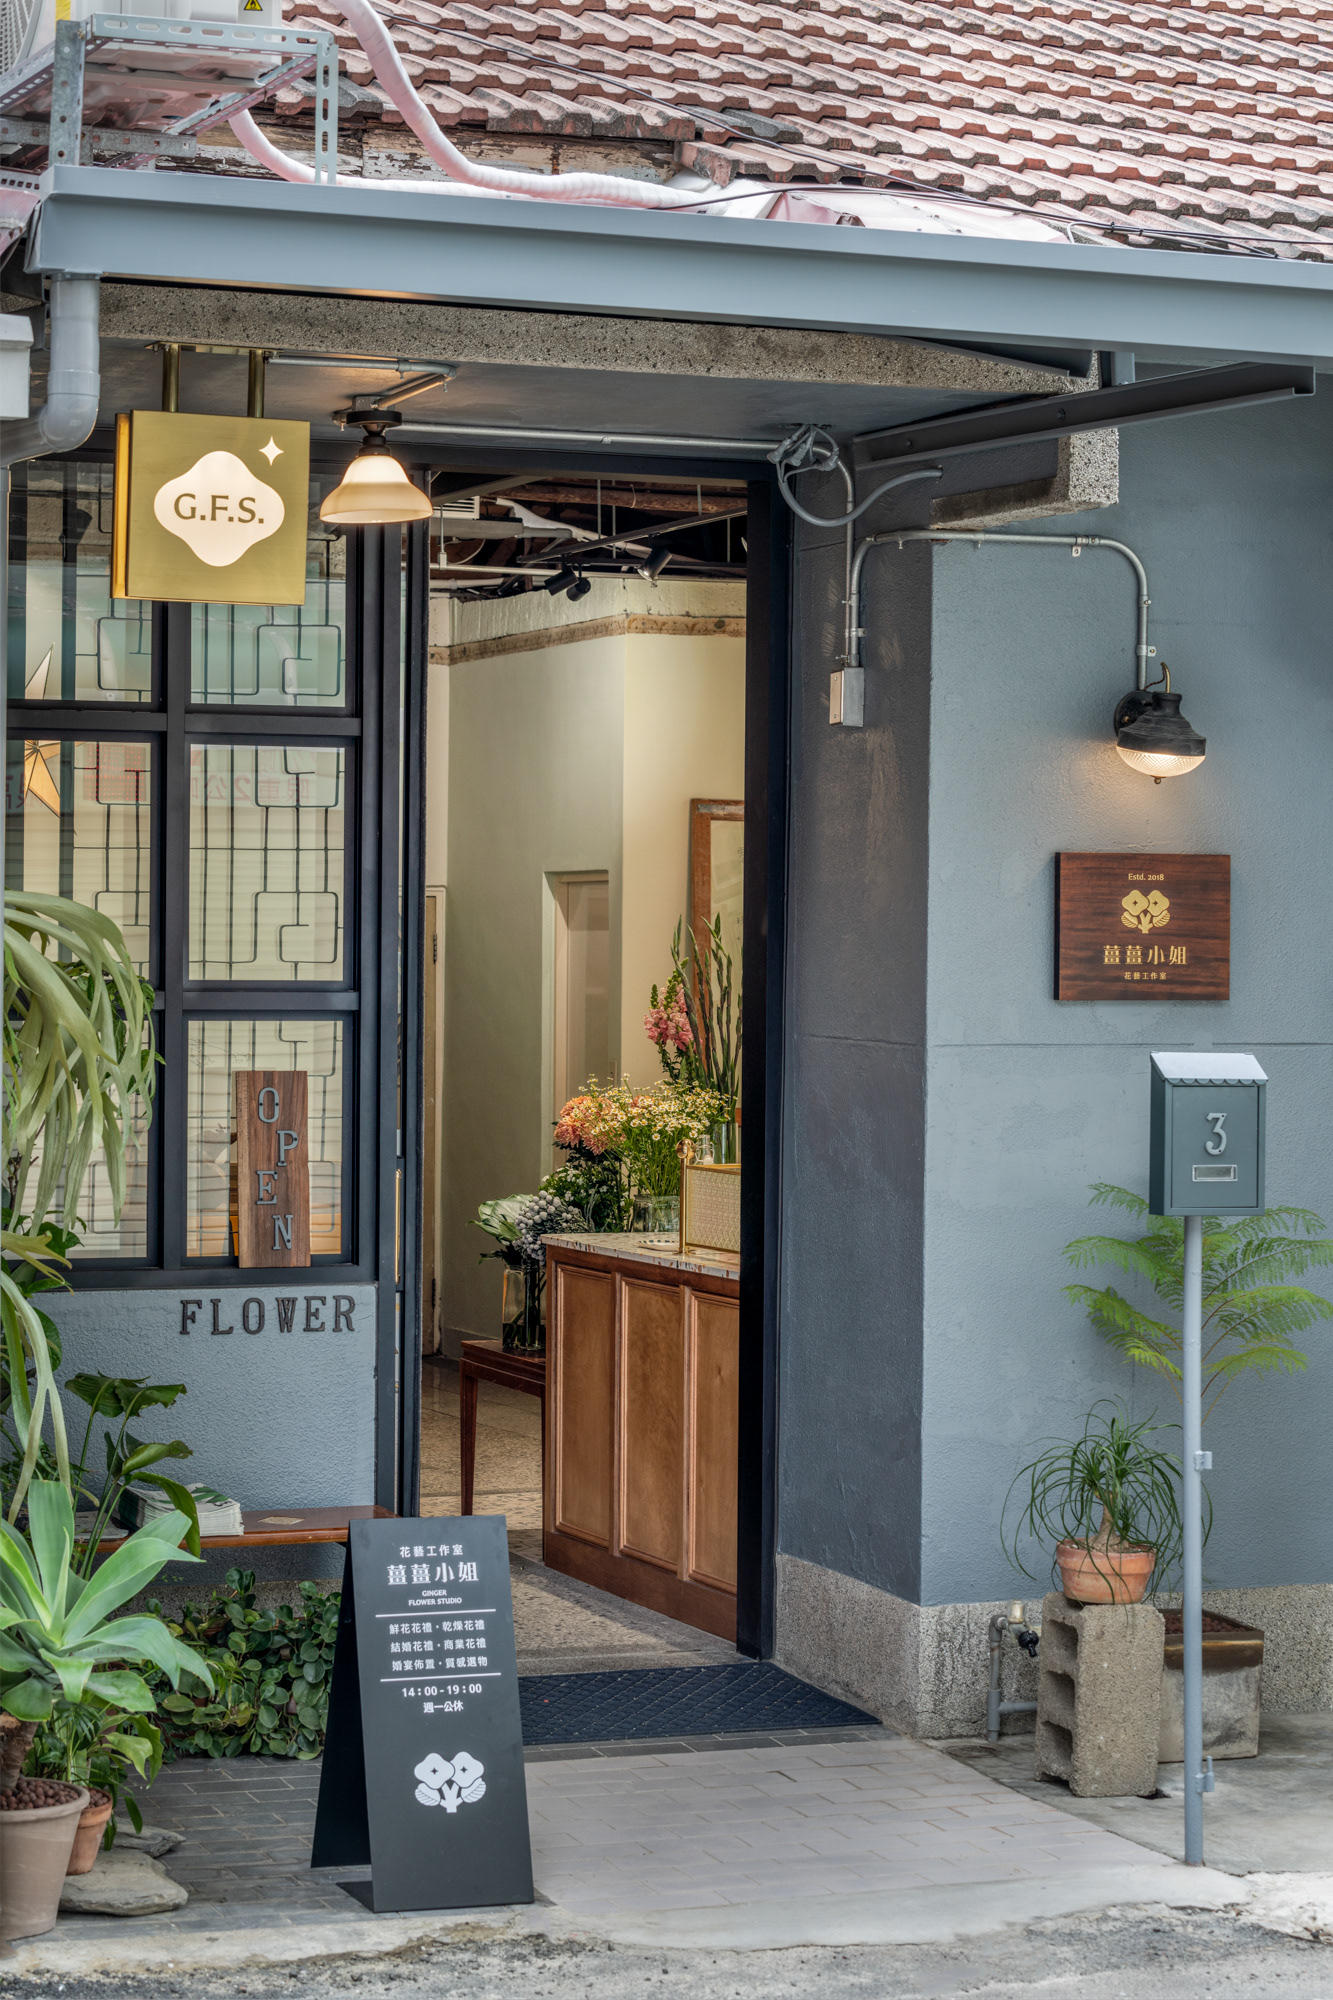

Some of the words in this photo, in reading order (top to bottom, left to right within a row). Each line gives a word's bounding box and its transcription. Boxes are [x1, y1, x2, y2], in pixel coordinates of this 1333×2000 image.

[174, 493, 264, 524] G.F.S.
[1128, 873, 1146, 881] Estd.
[1147, 873, 1165, 881] 2018
[1103, 944, 1187, 965] 薑薑小姐
[1124, 971, 1167, 980] 花藝工作室
[1205, 1112, 1227, 1155] 3
[256, 1087, 299, 1250] OPEN
[180, 1295, 356, 1335] FLOWER
[399, 1544, 463, 1558] 花藝工作室
[387, 1561, 479, 1586] 薑薑小姐
[408, 1598, 436, 1607] FLOWER
[437, 1597, 462, 1605] STUDIO
[421, 1589, 447, 1597] GINGER
[423, 1699, 464, 1714] 週一公休
